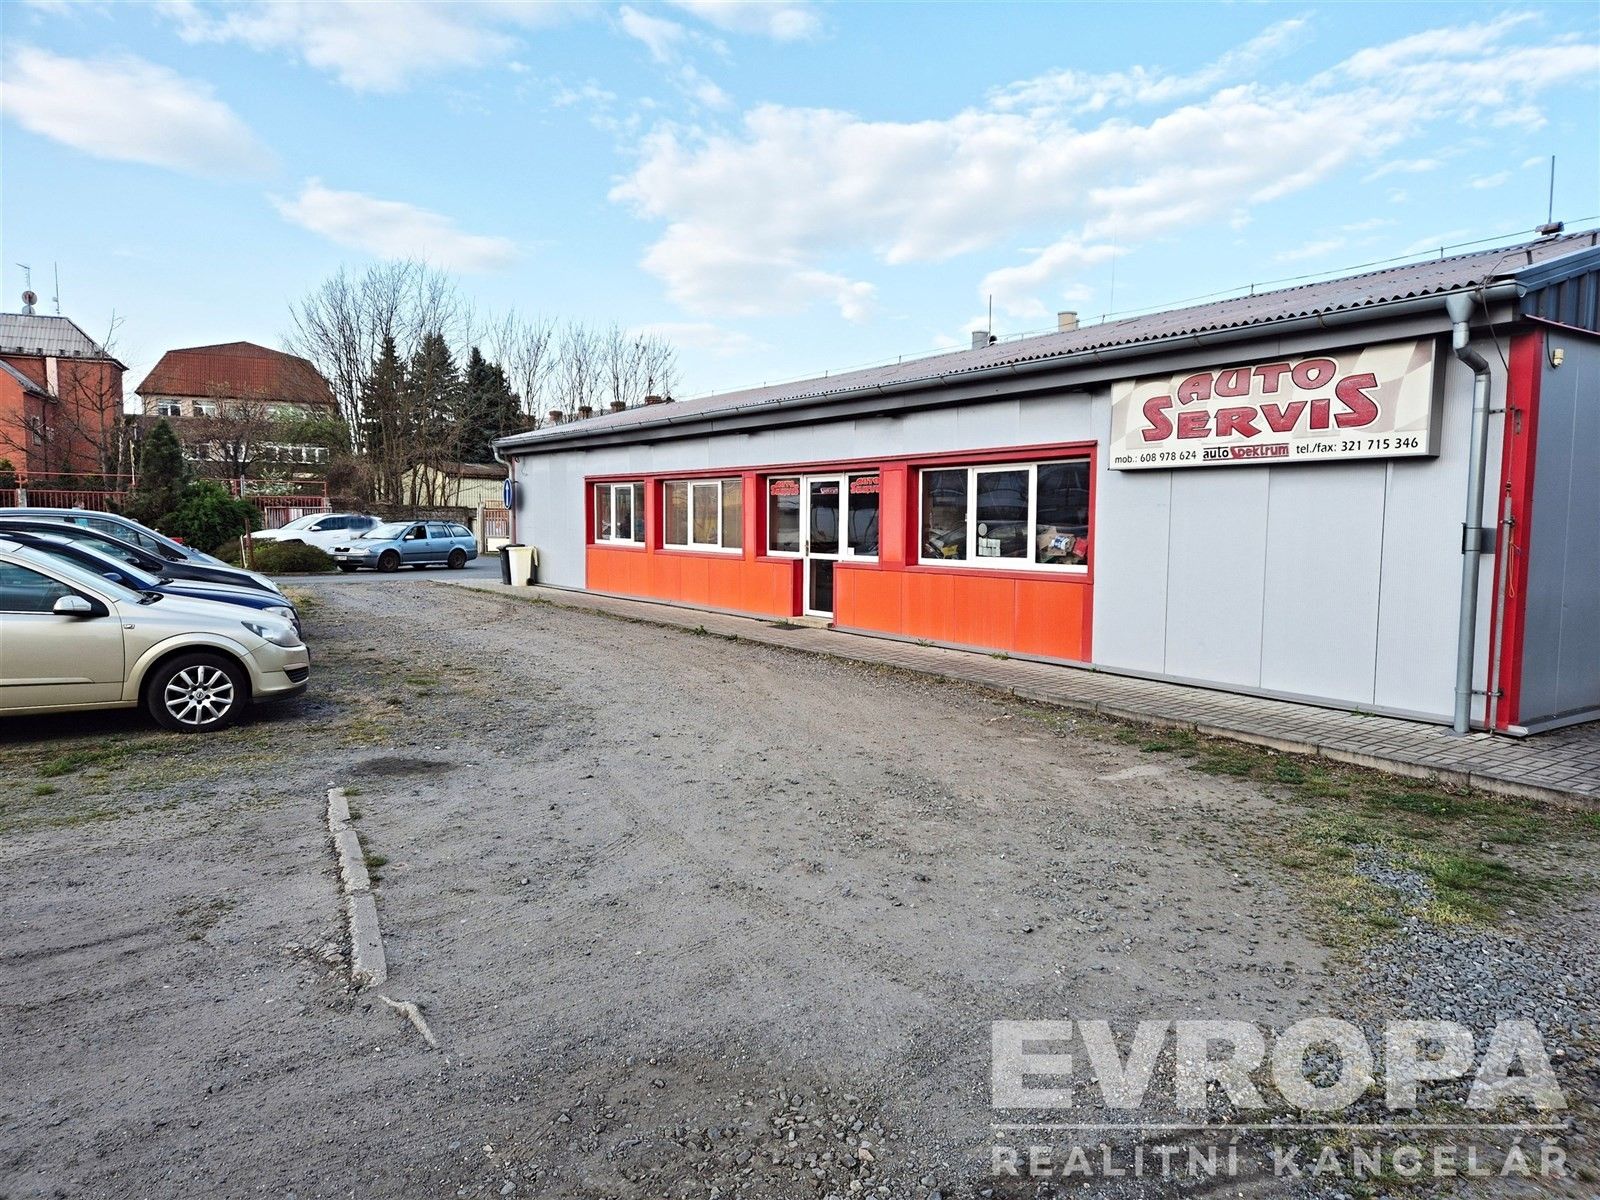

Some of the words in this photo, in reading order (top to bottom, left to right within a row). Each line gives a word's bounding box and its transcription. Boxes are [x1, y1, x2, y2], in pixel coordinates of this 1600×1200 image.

[1177, 358, 1337, 405] AUTO
[1141, 372, 1379, 443] SERVIS
[1139, 451, 1157, 463] 608
[1158, 450, 1177, 461] 978
[1179, 449, 1197, 460] 624
[1340, 439, 1362, 452] 321
[1367, 438, 1391, 450] 715
[1394, 436, 1419, 449] 346
